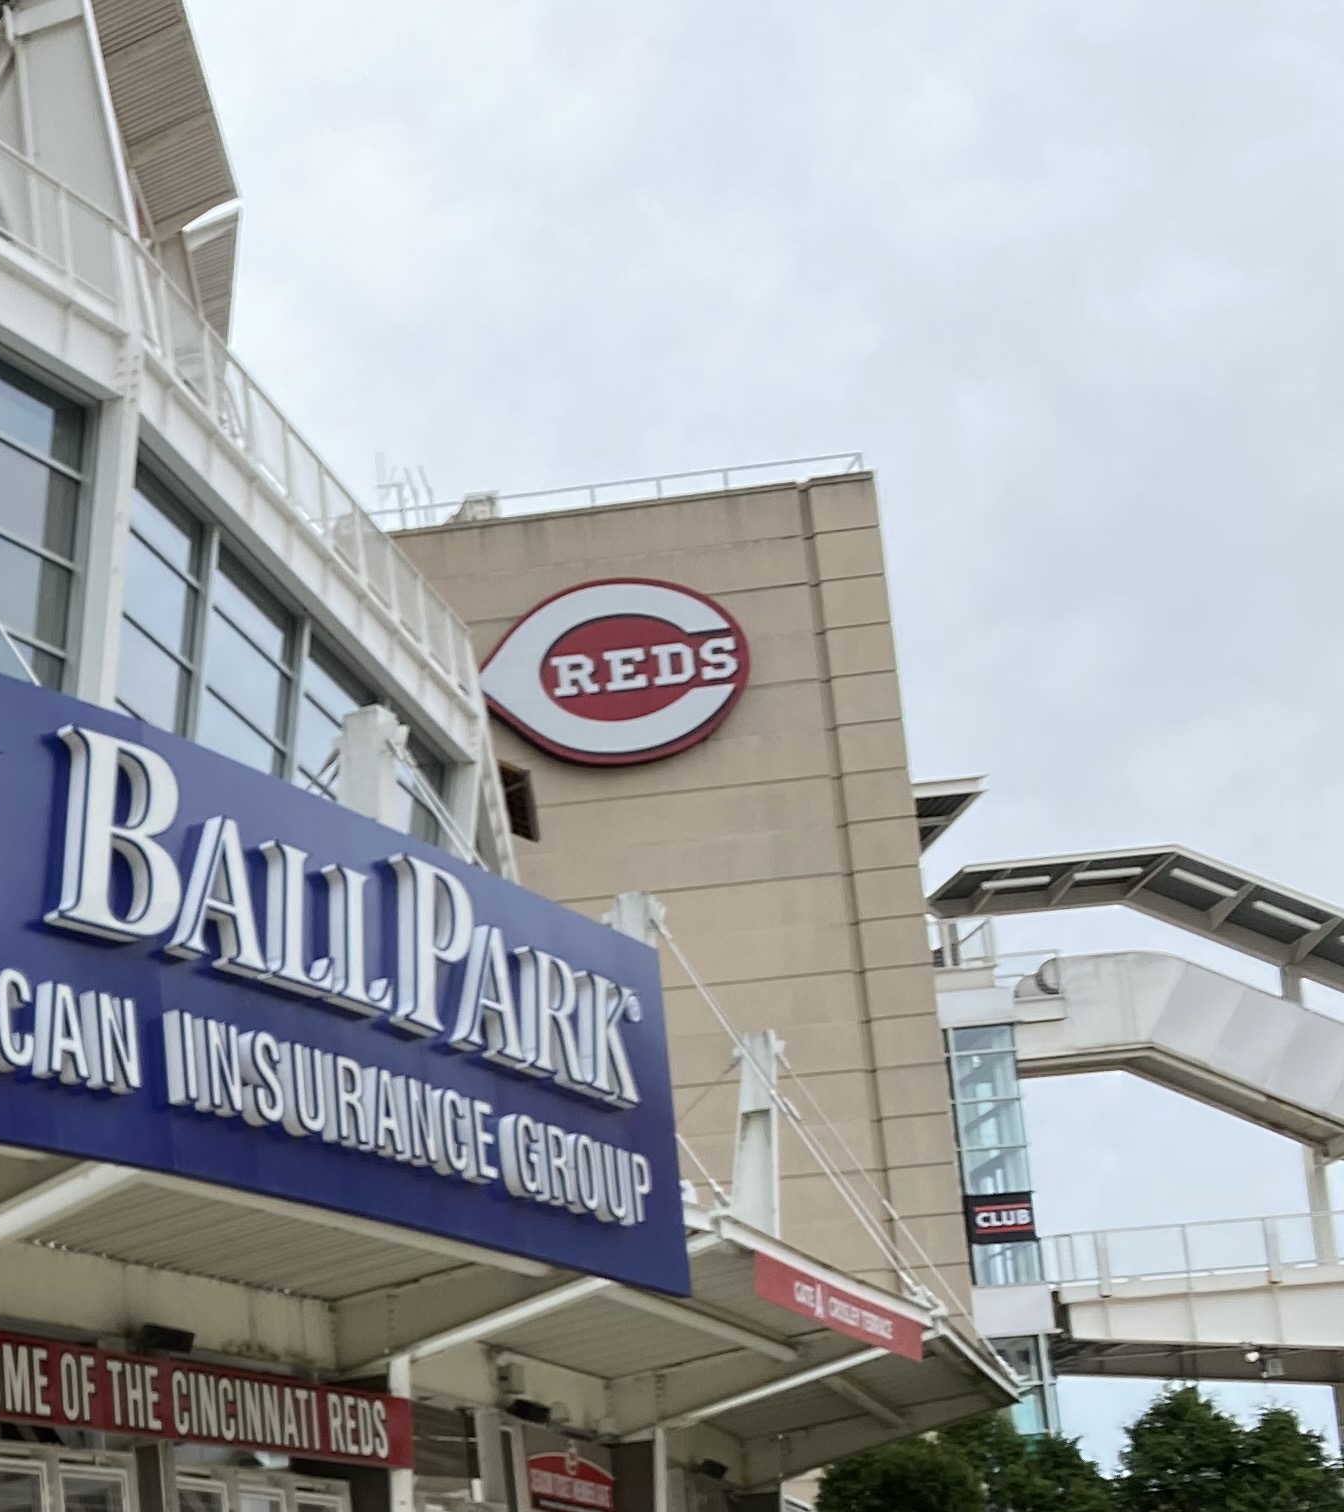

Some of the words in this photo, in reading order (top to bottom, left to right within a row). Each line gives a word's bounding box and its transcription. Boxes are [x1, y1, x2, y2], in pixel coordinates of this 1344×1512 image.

[549, 634, 740, 698] REDS
[164, 1009, 499, 1186] INSURANCE
[500, 1113, 651, 1228] GROUP
[975, 1208, 1031, 1228] CLUB
[60, 1352, 96, 1422] OF
[107, 1360, 162, 1431] THE
[172, 1369, 323, 1452] CINCINNATI
[326, 1396, 388, 1459] REDS
